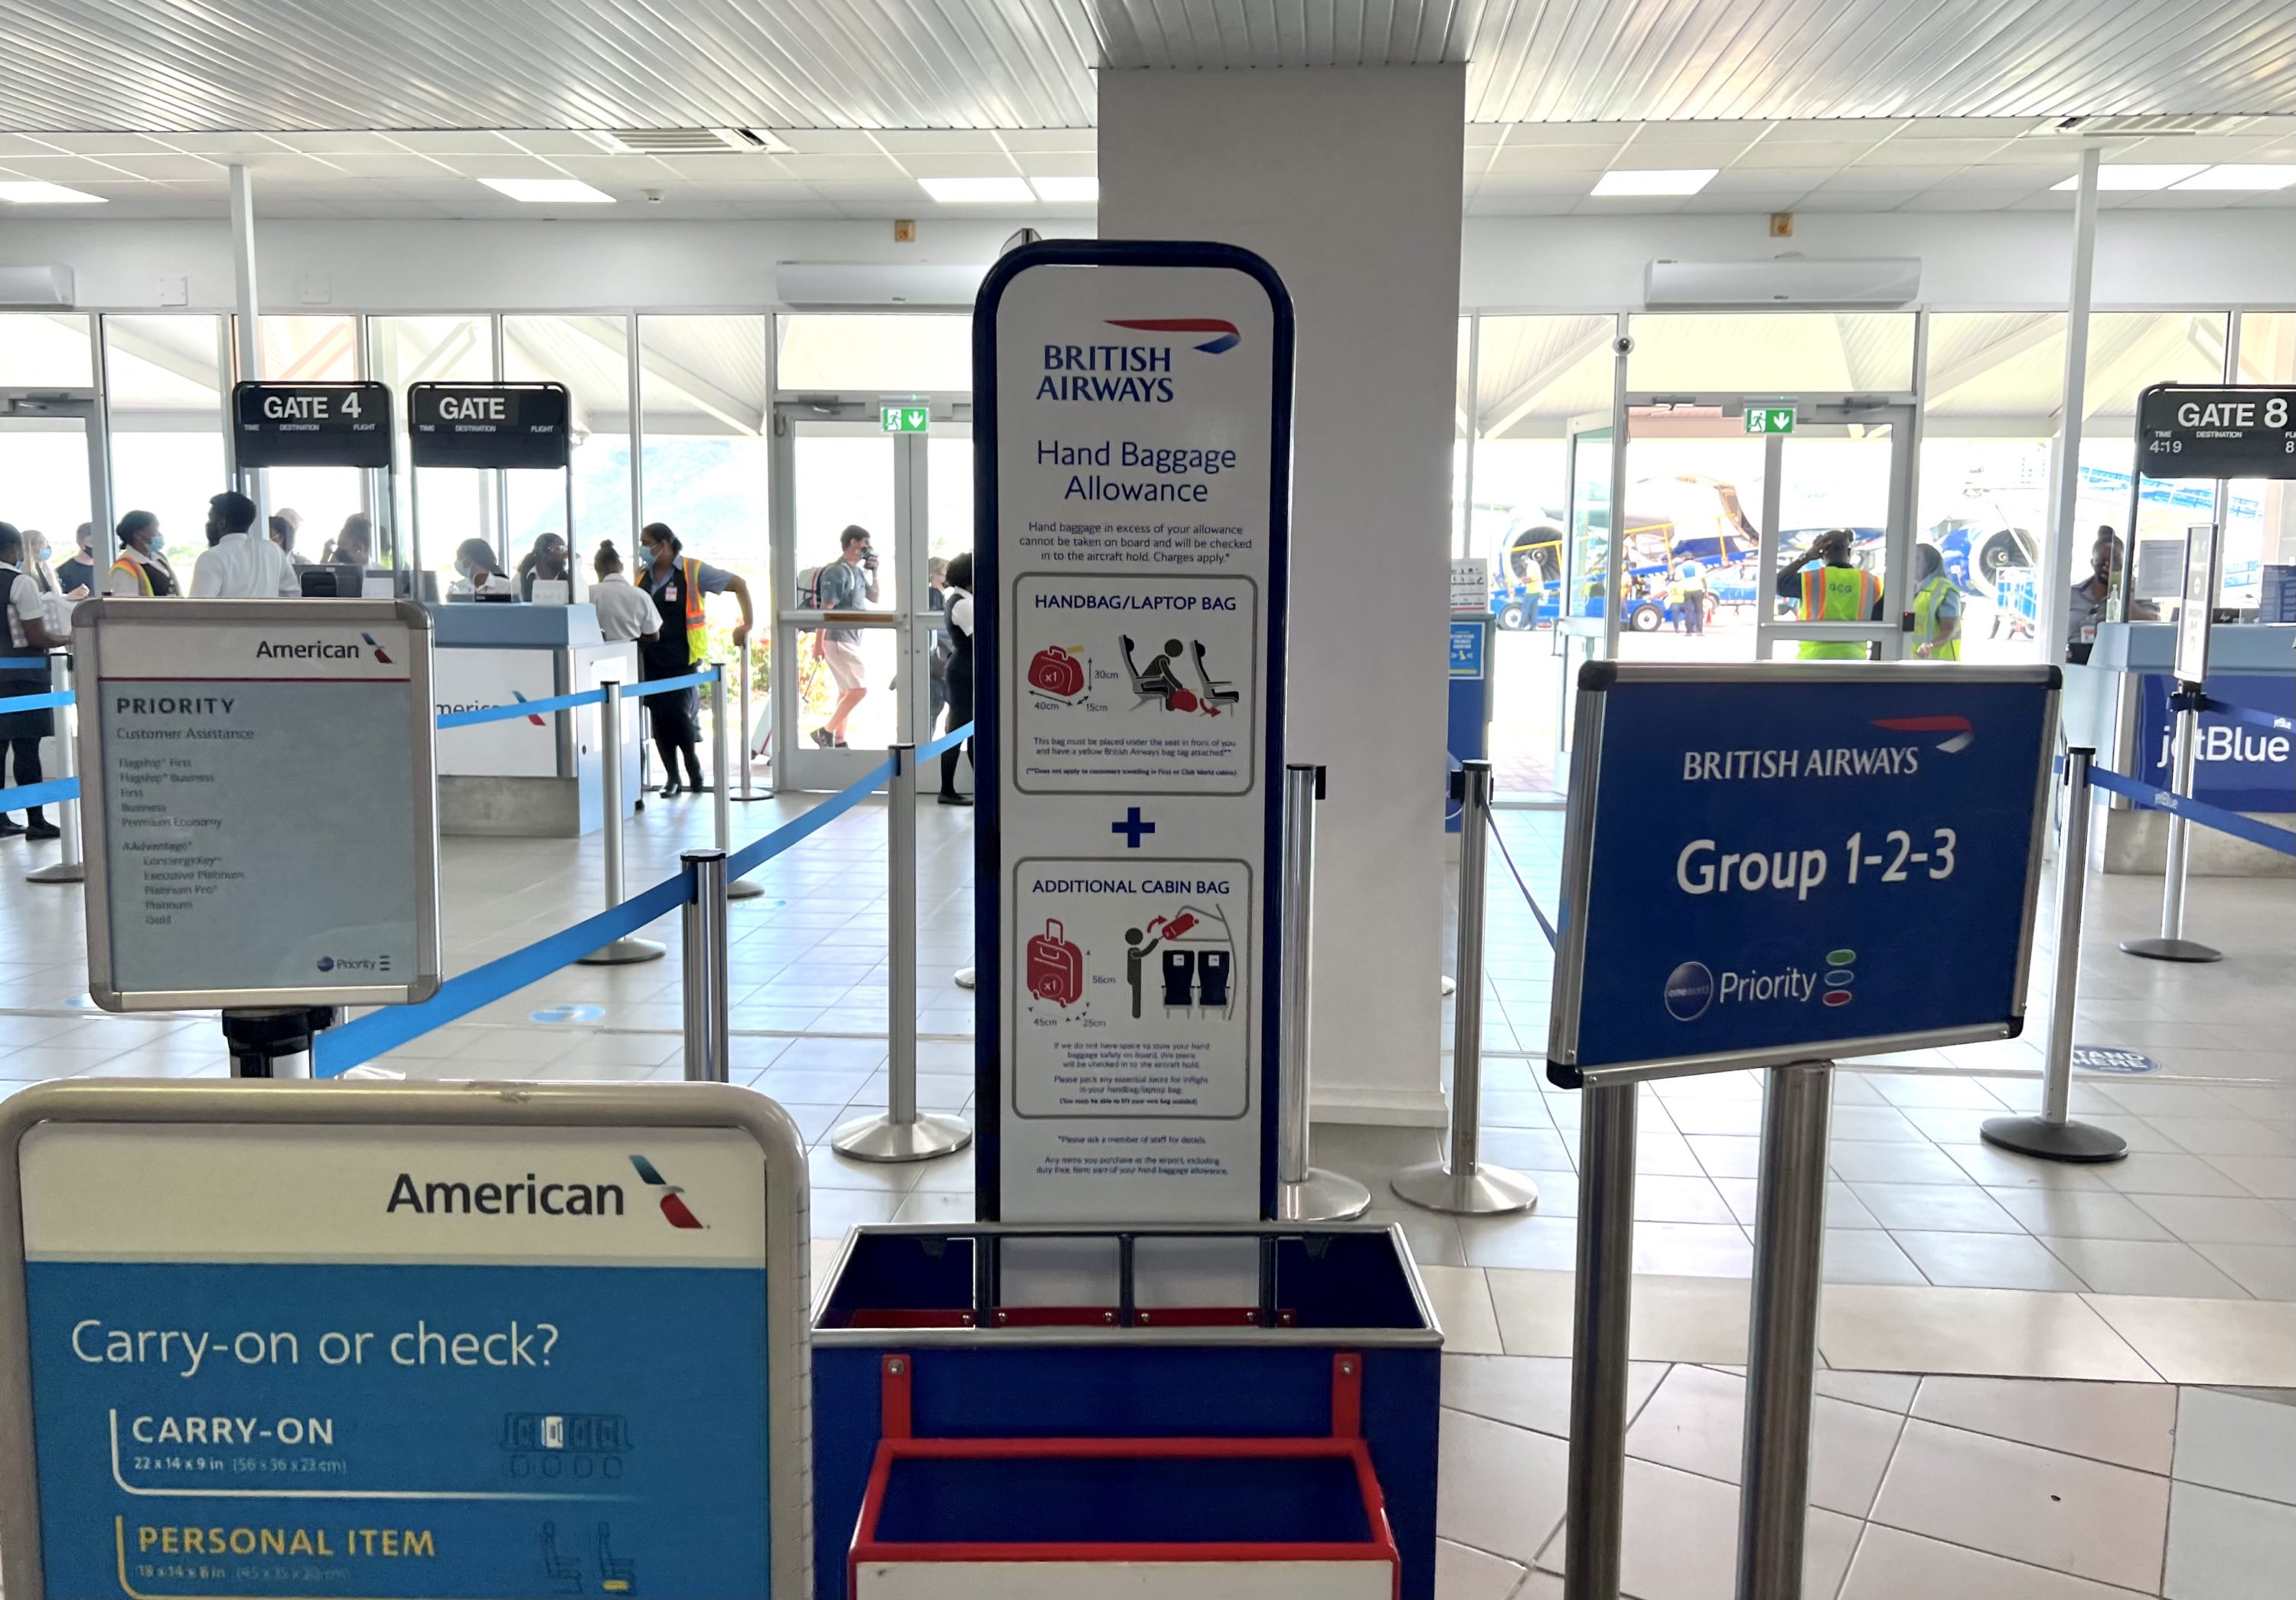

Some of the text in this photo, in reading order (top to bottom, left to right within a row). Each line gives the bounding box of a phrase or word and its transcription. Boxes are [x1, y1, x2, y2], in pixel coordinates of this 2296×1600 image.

[1045, 345, 1170, 372] BRITISH
[1036, 376, 1173, 403] AIRWAYS
[264, 391, 361, 418] GATE 4
[439, 397, 505, 420] GATE
[2178, 398, 2288, 428] GATE 8
[2150, 439, 2181, 452] 4:19
[1039, 439, 1237, 474] Hand Baggage
[1065, 475, 1208, 502] Allowance
[1029, 521, 1055, 532] Hand
[1060, 522, 1101, 535] baggage
[1117, 525, 1150, 534] excess
[1154, 523, 1163, 533] of
[1167, 527, 1190, 536] your
[1193, 524, 1242, 535] allowance
[1058, 536, 1070, 546] be
[1074, 536, 1101, 547] taken
[1121, 537, 1150, 547] board
[1153, 537, 1171, 547] and
[1175, 537, 1190, 548] will
[1195, 538, 1206, 548] be
[1210, 539, 1251, 549] checked
[1054, 552, 1064, 560] to
[1068, 550, 1084, 560] the
[1088, 550, 1123, 561] aircraft
[1154, 551, 1194, 564] Charges
[1035, 595, 1235, 610] HANDBAG/LAPTOP BAG
[256, 640, 359, 658] American
[1045, 670, 1118, 682] x1 30cm
[117, 697, 233, 714] PRIORITY
[1034, 702, 1108, 712] 40cm 15cm
[116, 727, 254, 740] Customer Assistance
[1052, 737, 1065, 747] bag
[1100, 738, 1124, 748] placed
[1126, 738, 1147, 746] under
[1078, 748, 1102, 757] yellow
[1130, 748, 1159, 757] Airways
[1162, 749, 1175, 758] bag
[1177, 749, 1189, 758] tag
[2157, 726, 2290, 768] jtBlue
[1684, 746, 1919, 781] BRITISH AIRWAYS
[1677, 828, 1955, 900] Group 1-2-3
[1032, 880, 1229, 894] ADDITIONAL CABIN BAG
[1044, 975, 1116, 991] x1 56cm
[1720, 966, 1817, 1004] Priority
[2073, 1050, 2144, 1060] TAND
[386, 1173, 623, 1216] American
[72, 1320, 558, 1378] Carry-on or check?
[133, 1416, 332, 1444] CARRY-ON
[134, 1456, 151, 1470] 22
[165, 1457, 181, 1470] 14
[197, 1457, 207, 1471] 9
[210, 1457, 223, 1471] in
[139, 1527, 434, 1556] PERSONAL ITEM
